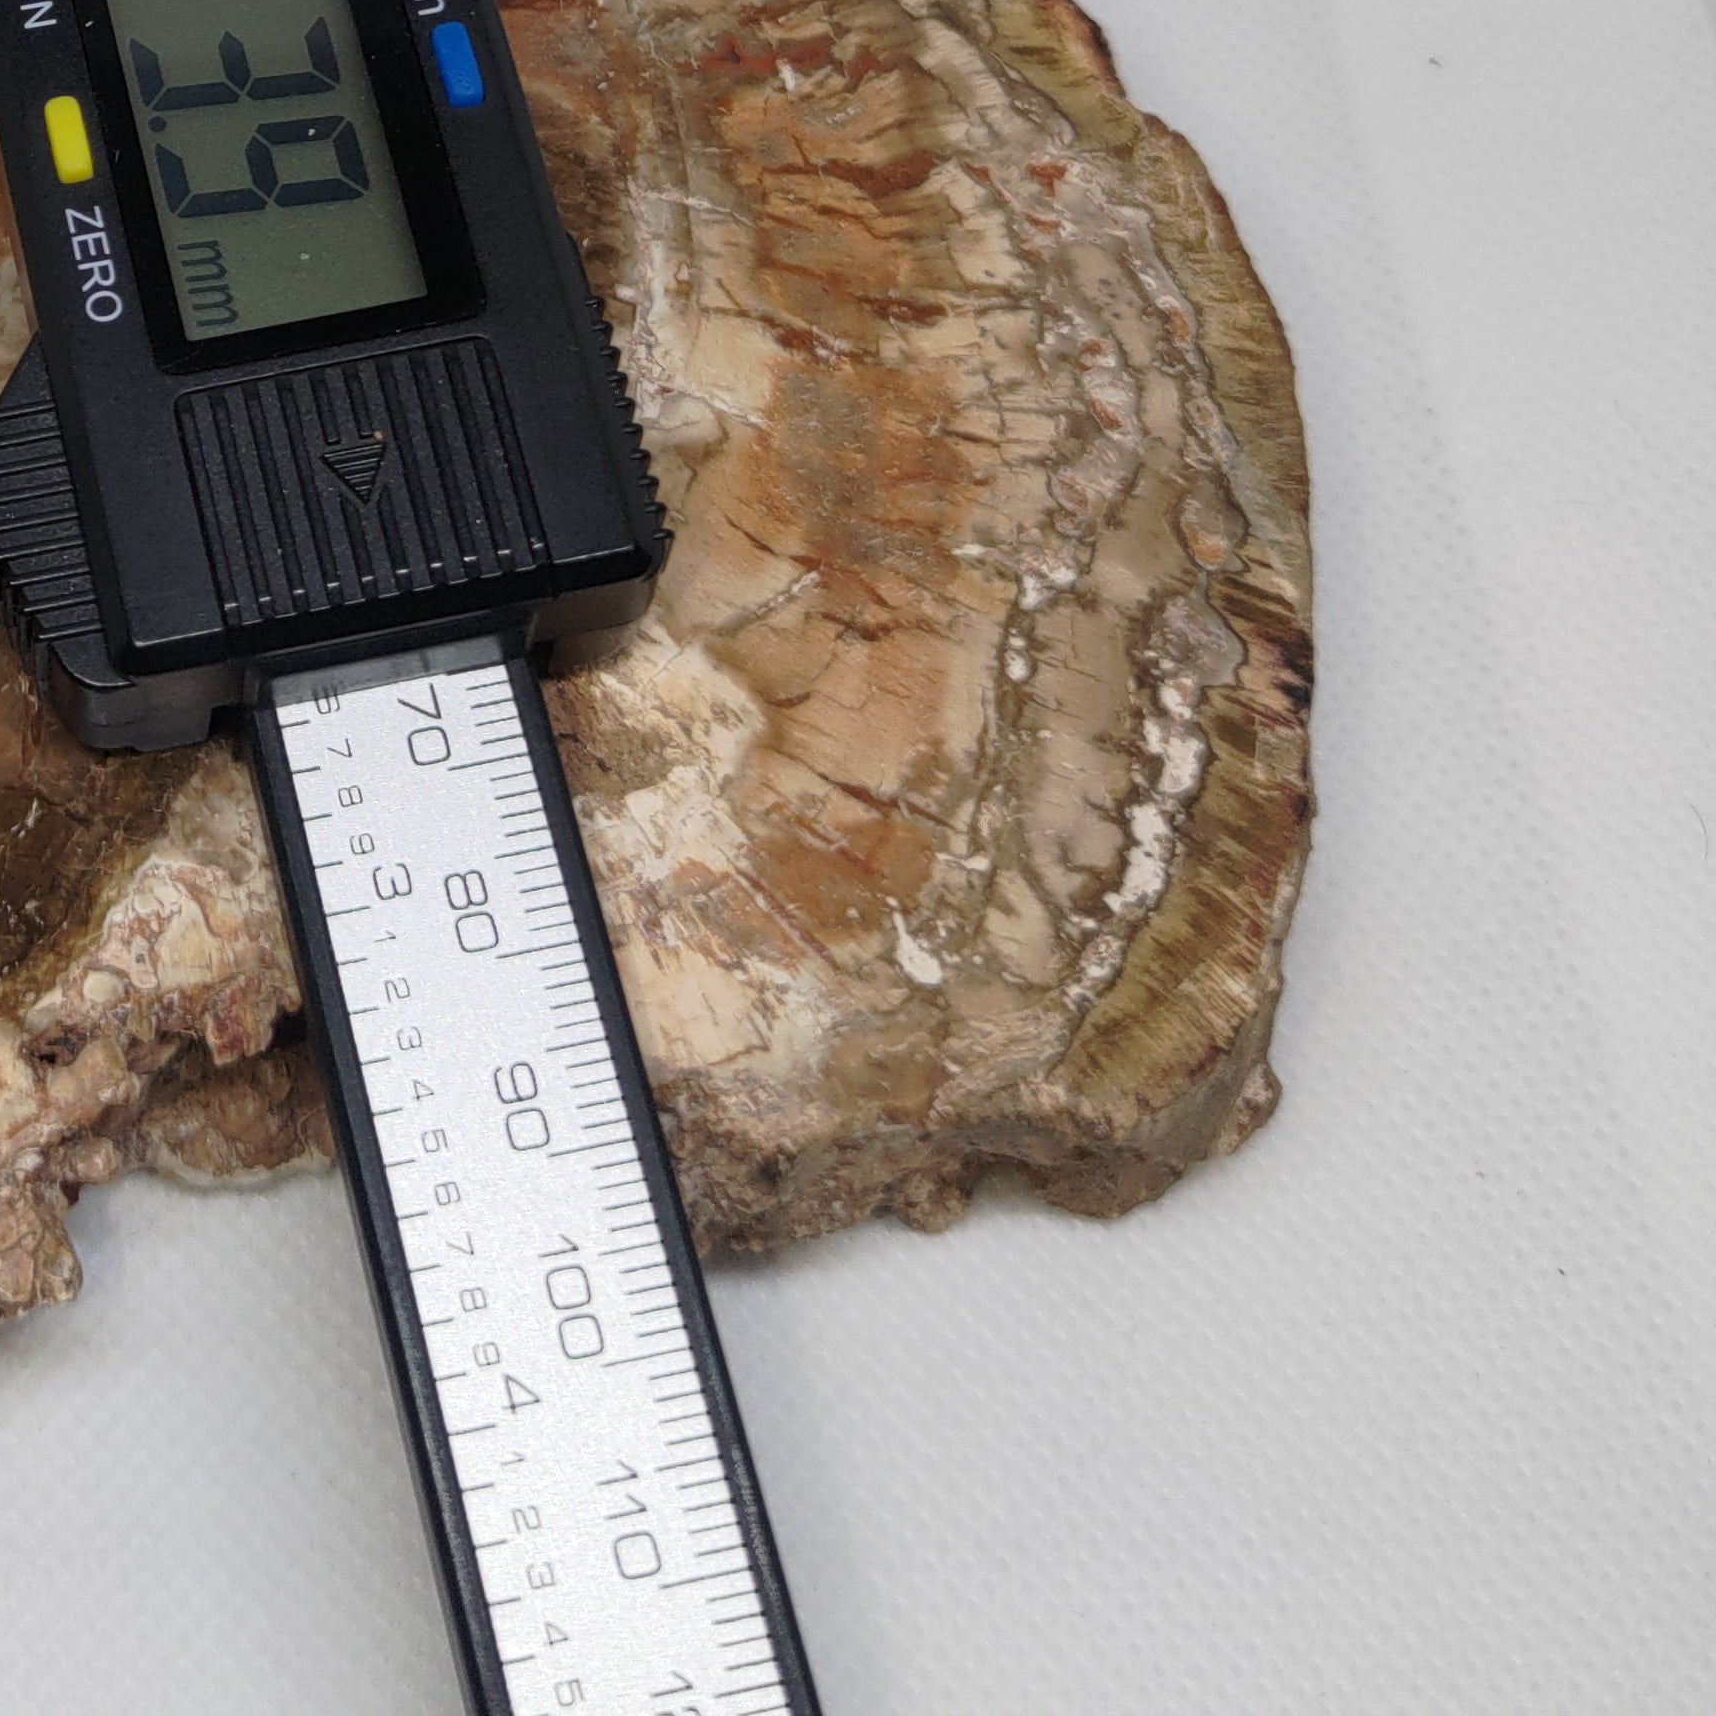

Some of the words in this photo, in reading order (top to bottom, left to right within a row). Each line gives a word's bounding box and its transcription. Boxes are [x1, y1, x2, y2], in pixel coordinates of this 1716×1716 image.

[129, 16, 370, 219] 3.9
[64, 206, 122, 324] ZERO
[176, 239, 239, 328] mm
[327, 738, 353, 759] 7
[337, 785, 364, 808] 8
[349, 833, 376, 856] 9
[372, 862, 413, 901] 3
[373, 929, 398, 944] 1
[383, 976, 412, 1003] 2
[396, 1025, 423, 1052] 3
[412, 1079, 435, 1102] 4
[397, 682, 452, 766] 70
[443, 869, 500, 954] 80
[493, 1061, 551, 1152] 90
[537, 1233, 605, 1361] 100
[597, 1459, 662, 1581] 110
[421, 1128, 449, 1154] 5
[434, 1181, 462, 1207] 6
[445, 1233, 475, 1257] 7
[460, 1287, 488, 1313] 8
[472, 1341, 501, 1368] 9
[503, 1372, 541, 1415] 4
[500, 1450, 526, 1466] 1
[511, 1505, 543, 1534] 2
[526, 1561, 556, 1590] 3
[543, 1620, 570, 1648] 4
[553, 1678, 585, 1708] 5
